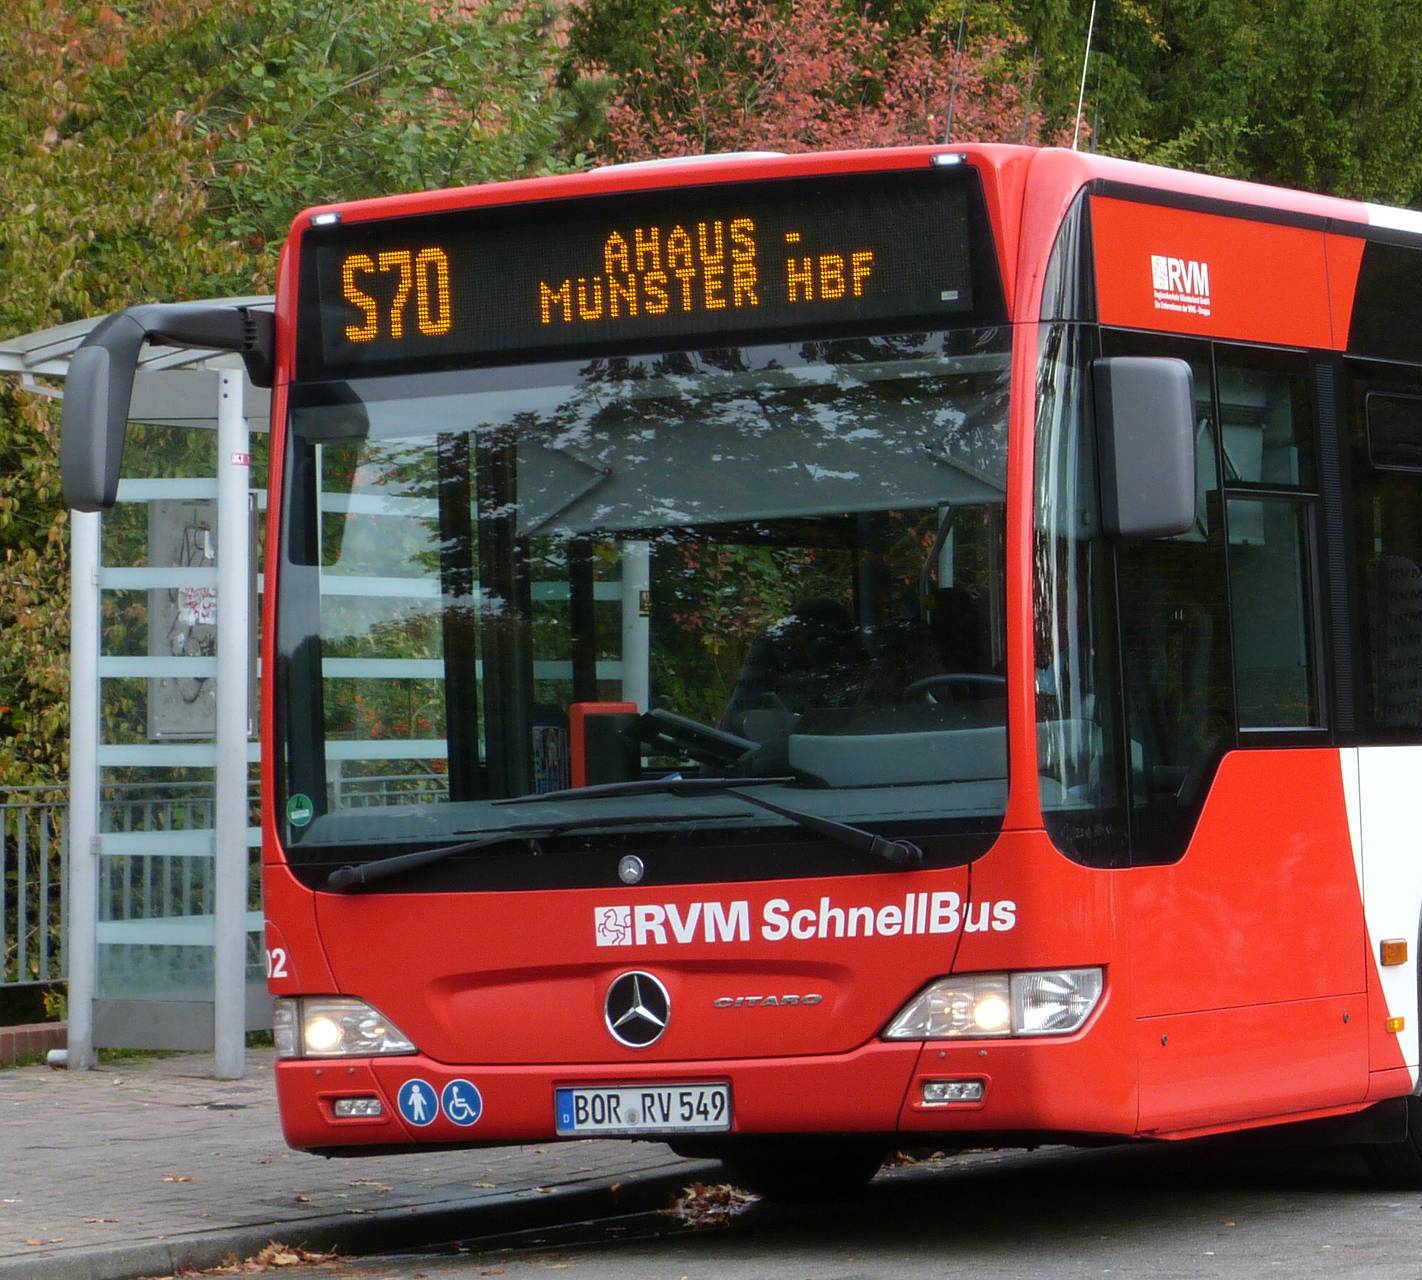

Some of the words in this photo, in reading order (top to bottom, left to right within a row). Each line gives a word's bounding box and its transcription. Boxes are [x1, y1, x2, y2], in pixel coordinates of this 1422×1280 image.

[604, 218, 756, 273] AHAUS
[342, 248, 451, 342] S70
[540, 262, 758, 324] MÜNSTER
[786, 251, 873, 302] HBF
[1167, 257, 1210, 297] RVM
[635, 900, 750, 945] RVM
[761, 891, 1017, 942] SchnellBus
[713, 993, 824, 1009] CITARO
[575, 1093, 622, 1125] BOR
[641, 1092, 672, 1124] RV
[679, 1090, 726, 1122] 549
